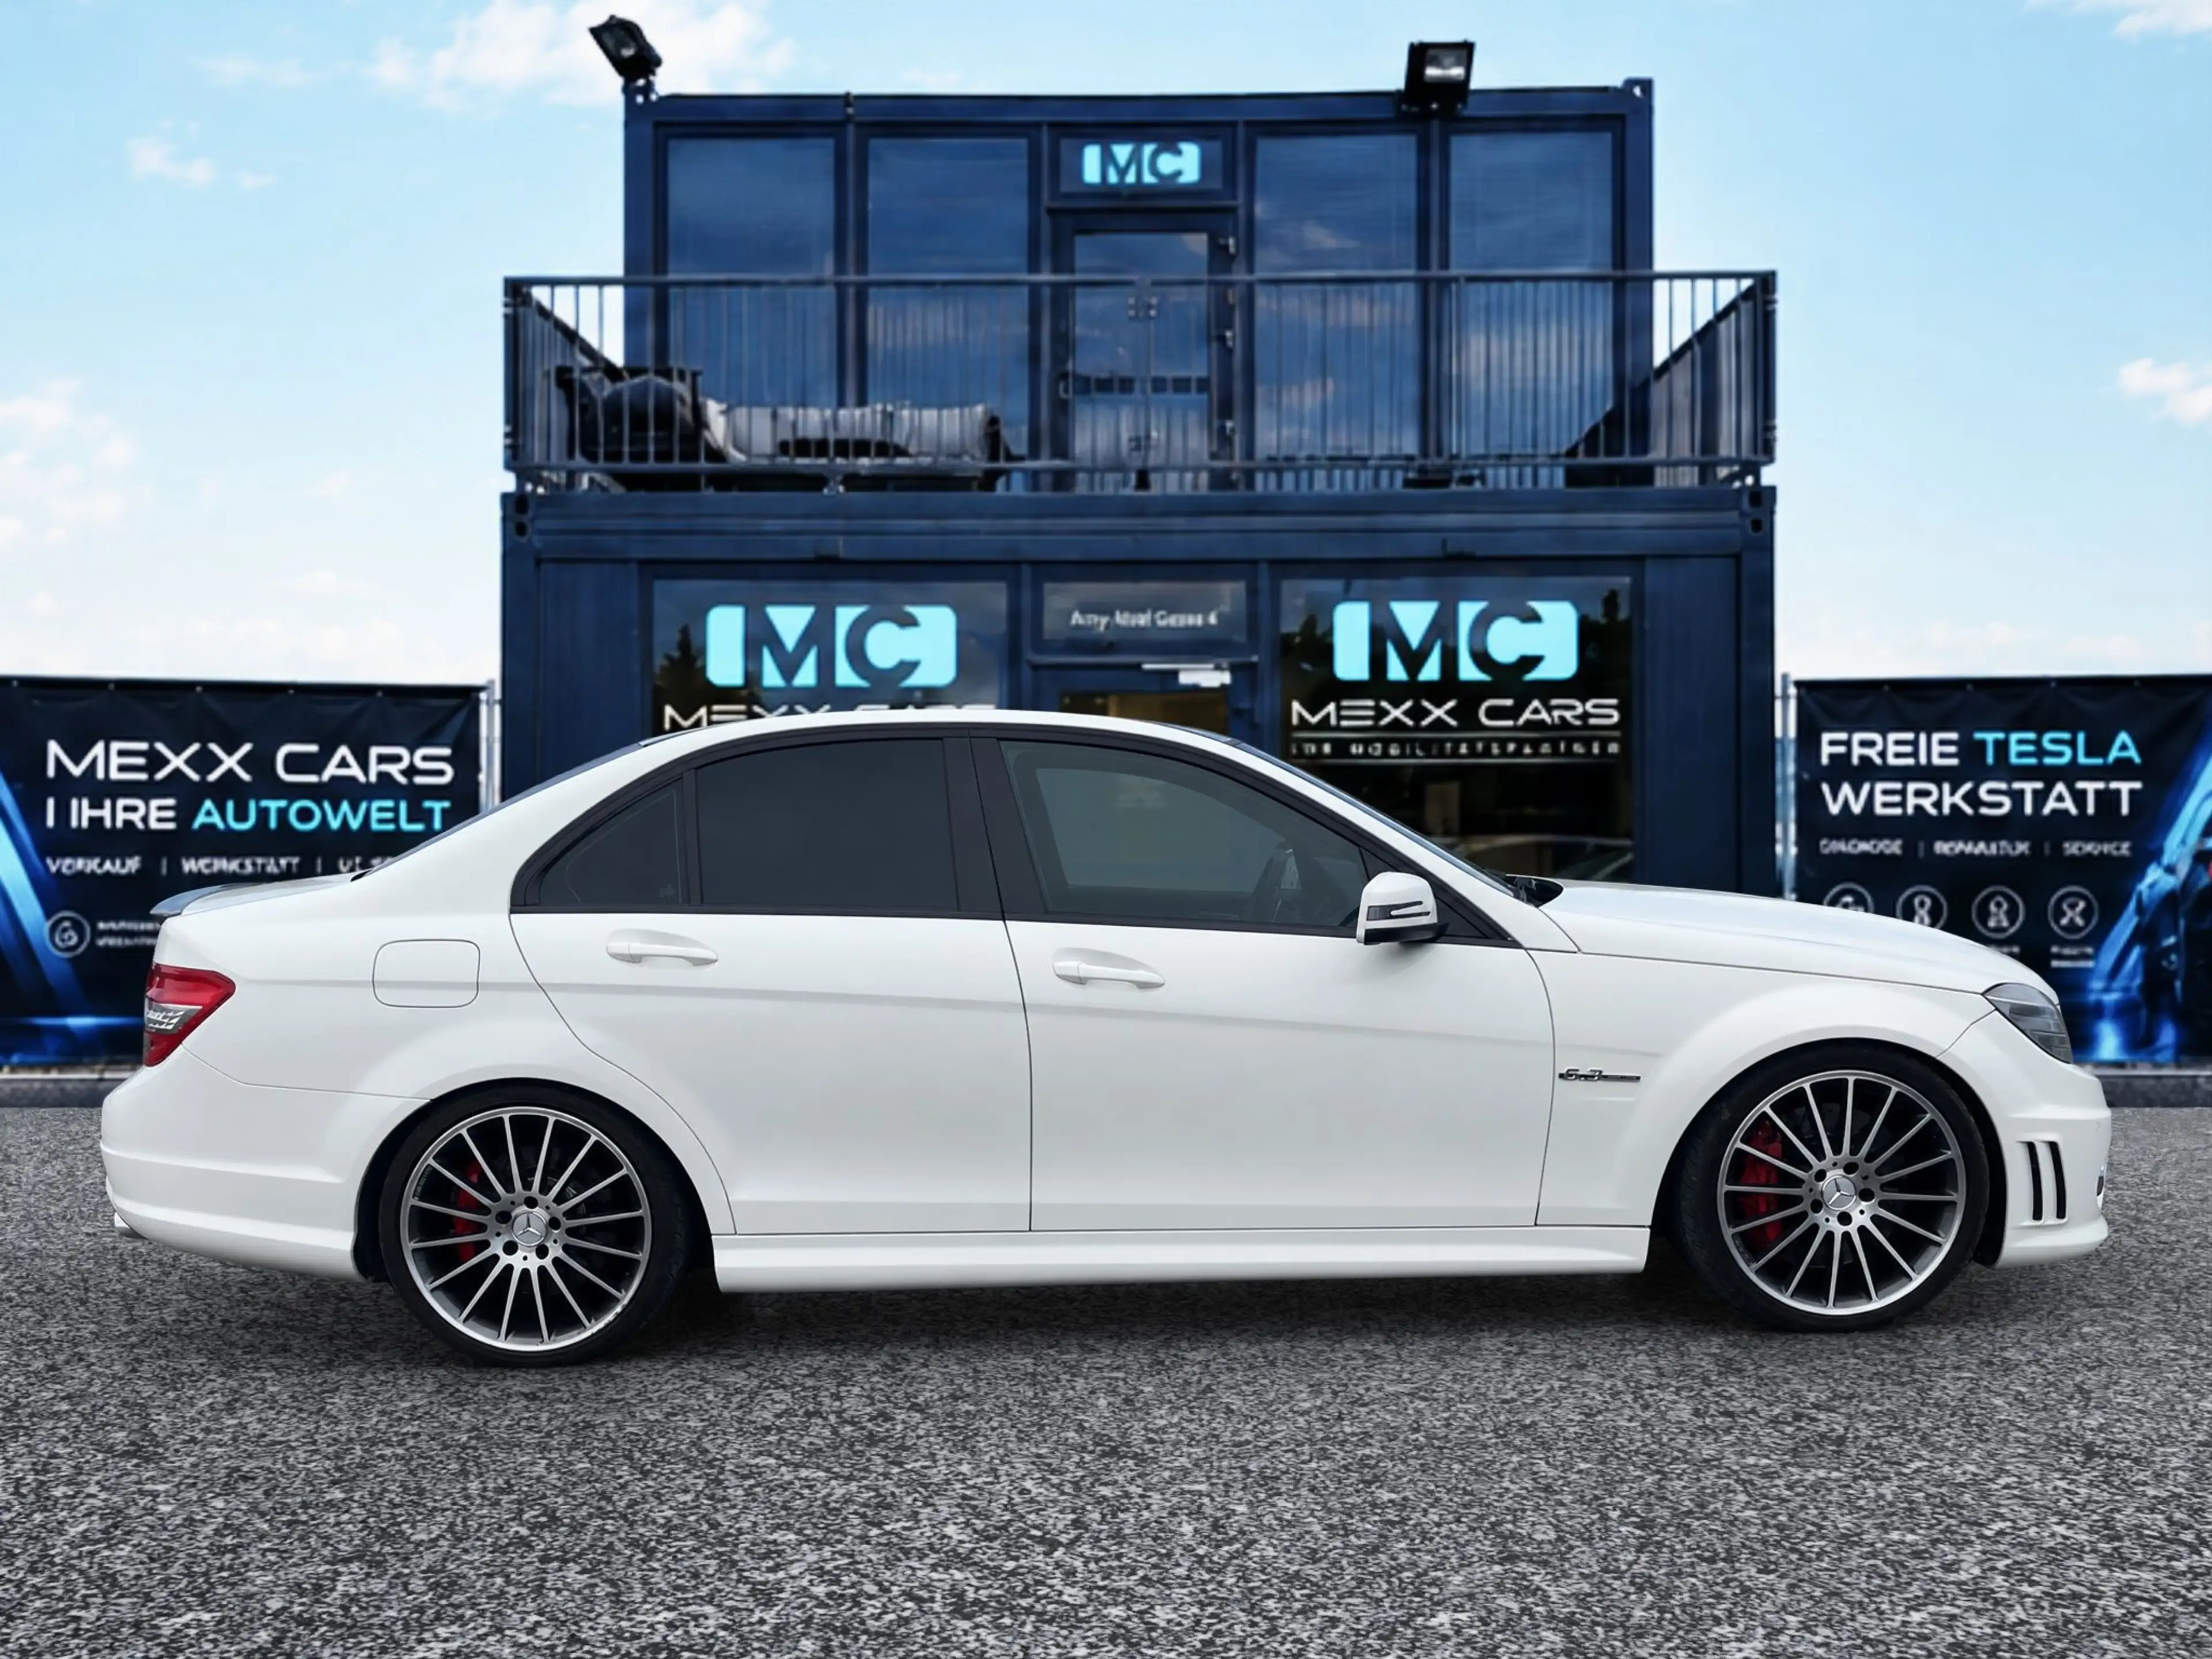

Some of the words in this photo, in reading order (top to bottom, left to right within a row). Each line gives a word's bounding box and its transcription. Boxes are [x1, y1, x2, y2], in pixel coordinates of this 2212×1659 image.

[1082, 142, 1201, 184] MC
[706, 604, 957, 687] MC
[1333, 600, 1578, 681] MC
[1291, 699, 1458, 727] MEXX
[1478, 698, 1621, 727] CARS
[47, 739, 253, 782] MEXX
[275, 743, 455, 785] CARS
[1820, 732, 1959, 766] FREIE
[1972, 730, 2142, 766] TESLA
[70, 797, 177, 830] IHRE
[191, 799, 452, 832] AUTOWELT
[1820, 781, 2143, 816] WERKSTATT
